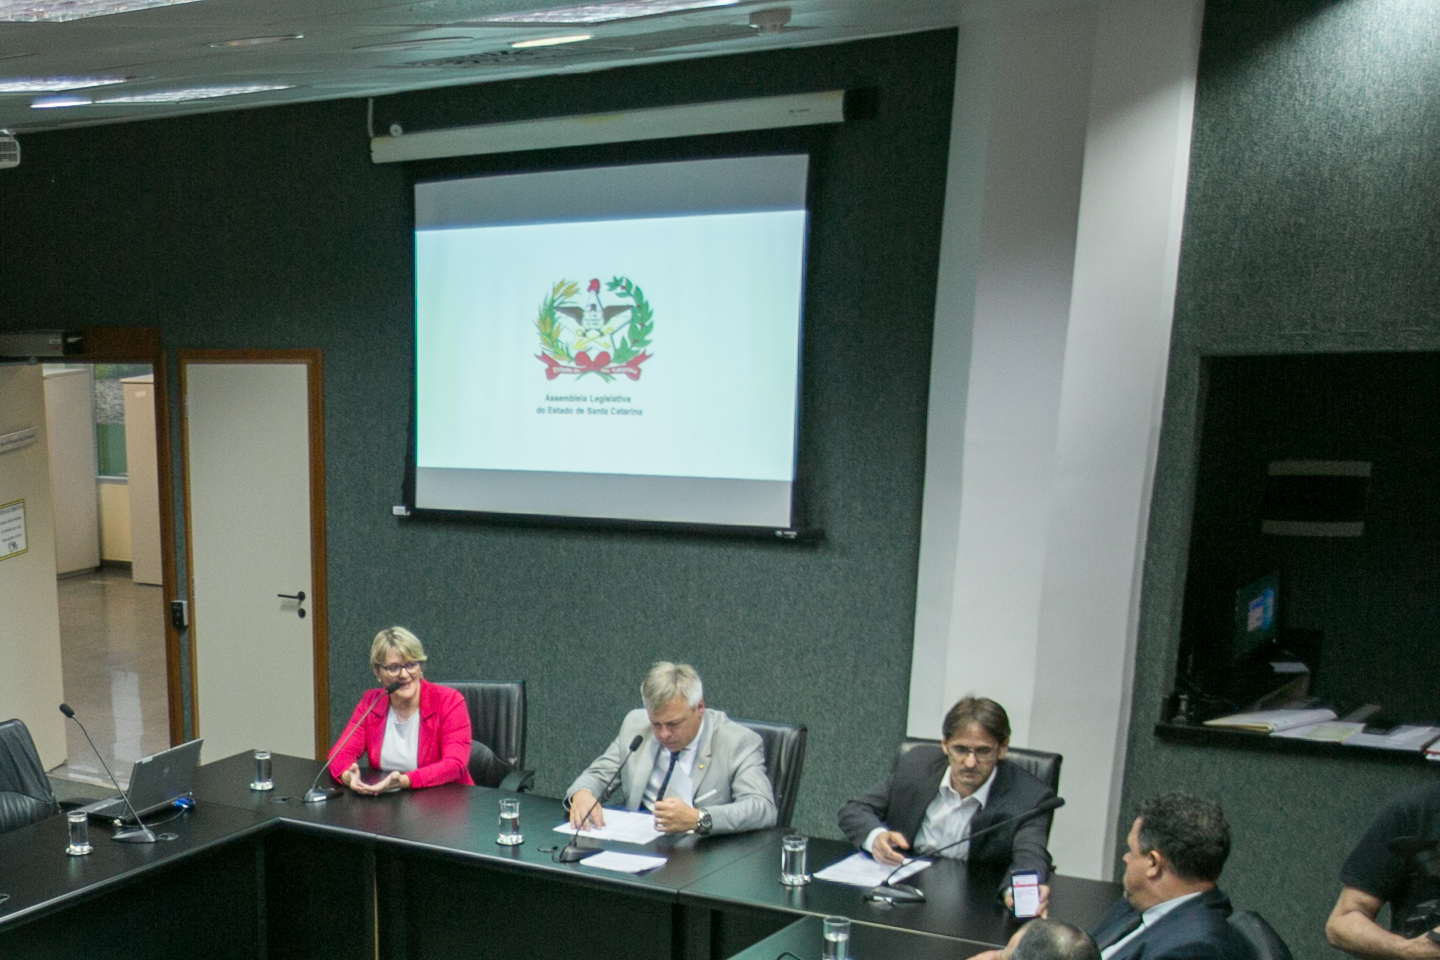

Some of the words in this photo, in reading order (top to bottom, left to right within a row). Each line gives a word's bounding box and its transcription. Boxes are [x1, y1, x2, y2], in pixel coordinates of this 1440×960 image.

[545, 394, 588, 403] Assembleia
[589, 394, 632, 404] Legislativa
[536, 406, 546, 415] do
[548, 406, 573, 415] Estado
[575, 406, 585, 415] de
[586, 407, 608, 415] Santa
[610, 407, 643, 416] Catarina
